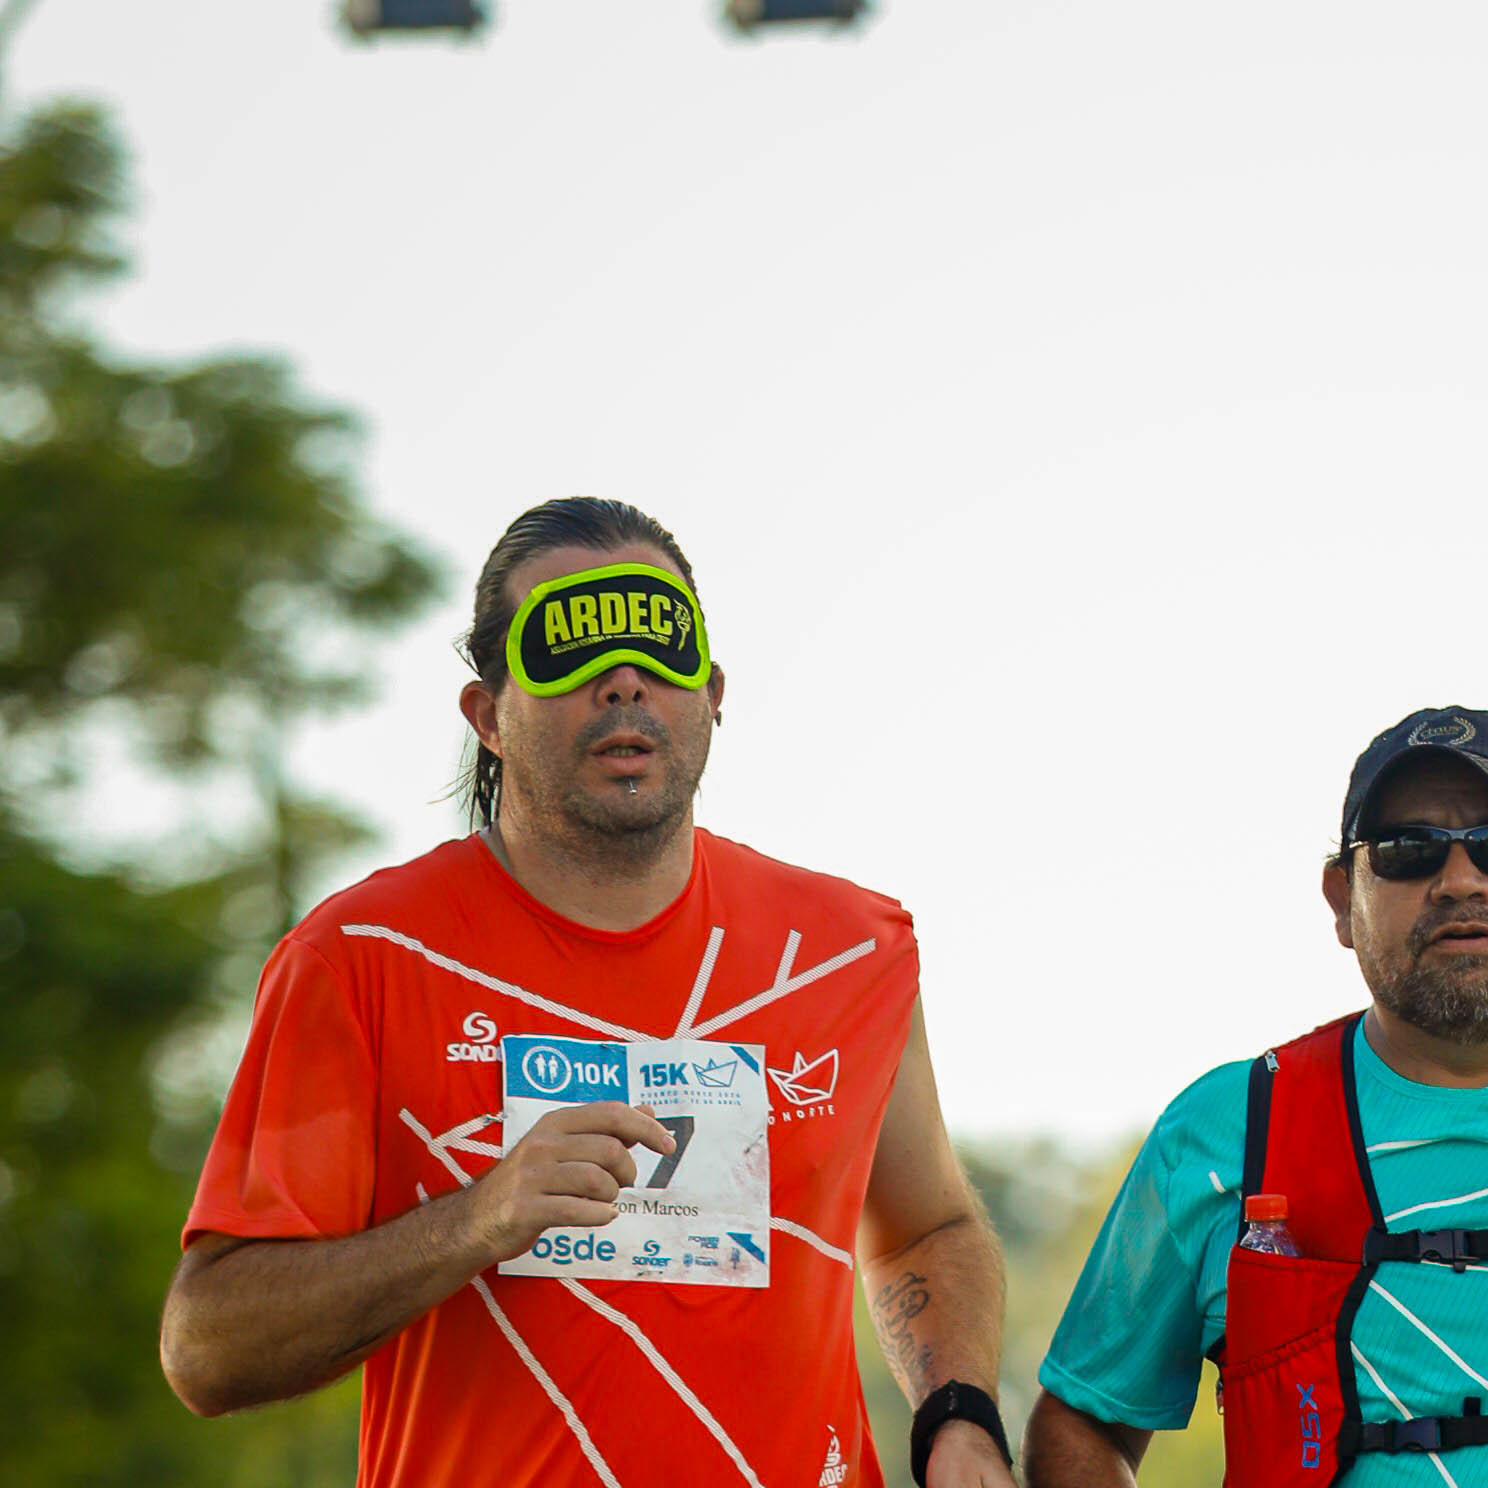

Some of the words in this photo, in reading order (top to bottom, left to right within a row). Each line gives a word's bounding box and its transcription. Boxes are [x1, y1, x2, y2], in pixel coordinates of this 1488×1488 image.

[545, 592, 673, 646] ARDEC
[574, 1062, 621, 1087] 10K
[640, 1062, 689, 1088] 15K
[782, 1104, 835, 1122] NORTE
[642, 1200, 699, 1216] Marcos
[532, 1232, 617, 1265] osde
[1296, 1383, 1321, 1469] OSX
